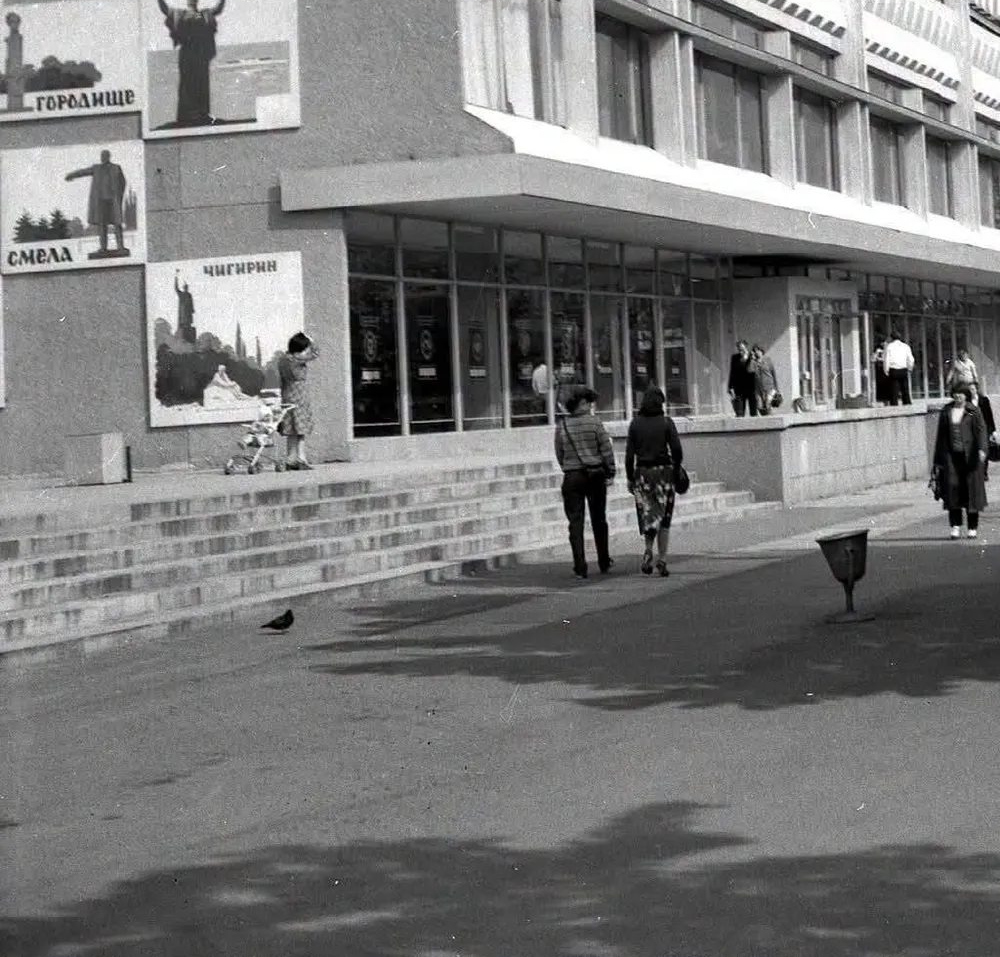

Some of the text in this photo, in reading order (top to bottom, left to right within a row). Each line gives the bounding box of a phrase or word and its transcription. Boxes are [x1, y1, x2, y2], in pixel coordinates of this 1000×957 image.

[36, 89, 135, 111] ГОРОДИЩЕ
[7, 246, 74, 266] СМЕЛА
[203, 260, 278, 277] ЧИГИРИН
